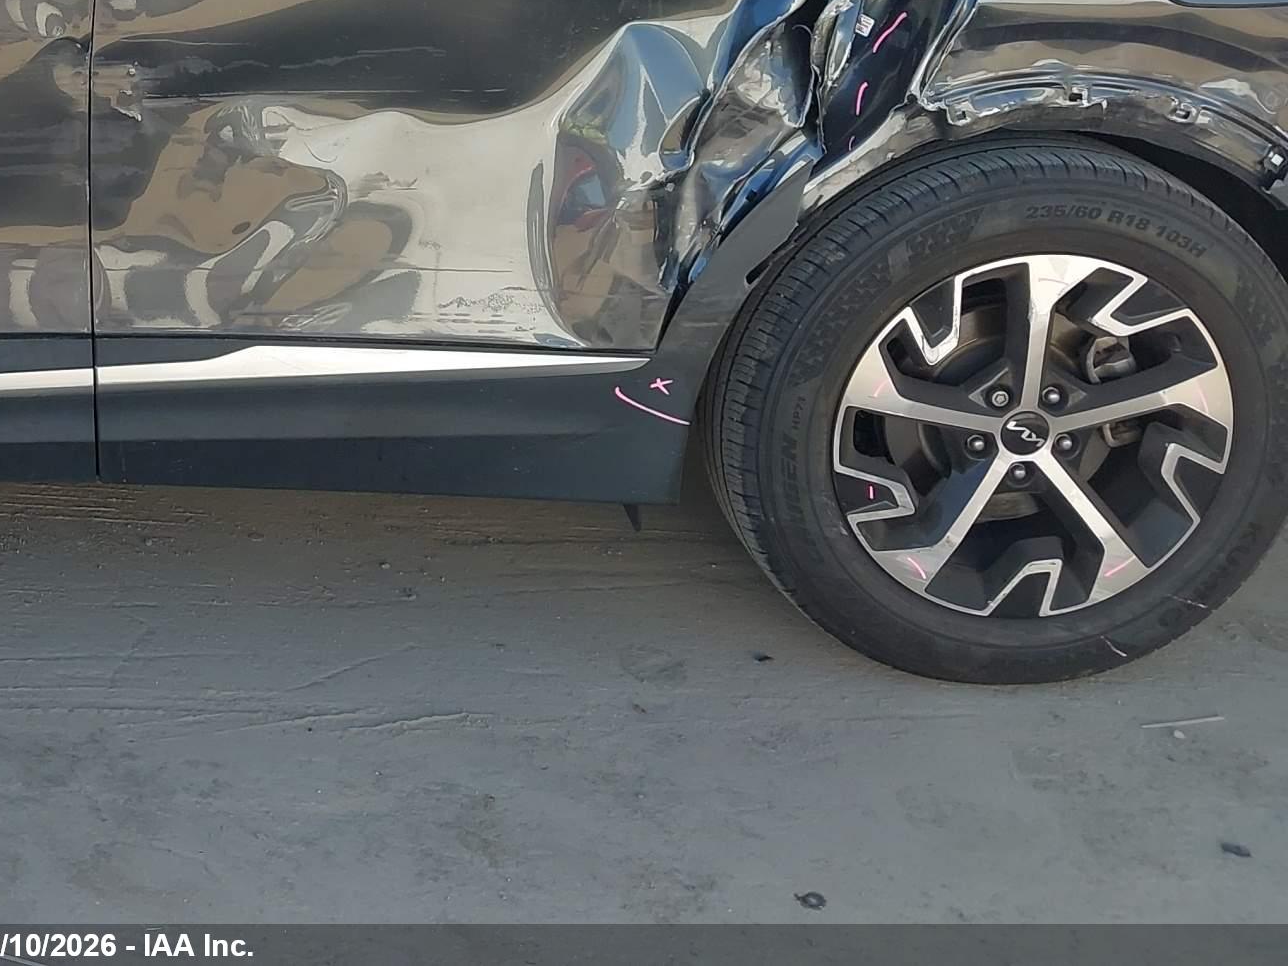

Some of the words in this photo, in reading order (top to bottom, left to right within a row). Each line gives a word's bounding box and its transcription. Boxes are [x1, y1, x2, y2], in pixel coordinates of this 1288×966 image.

[1026, 205, 1102, 220] 235/60
[1106, 212, 1151, 231] R18
[1155, 225, 1207, 258] 103H
